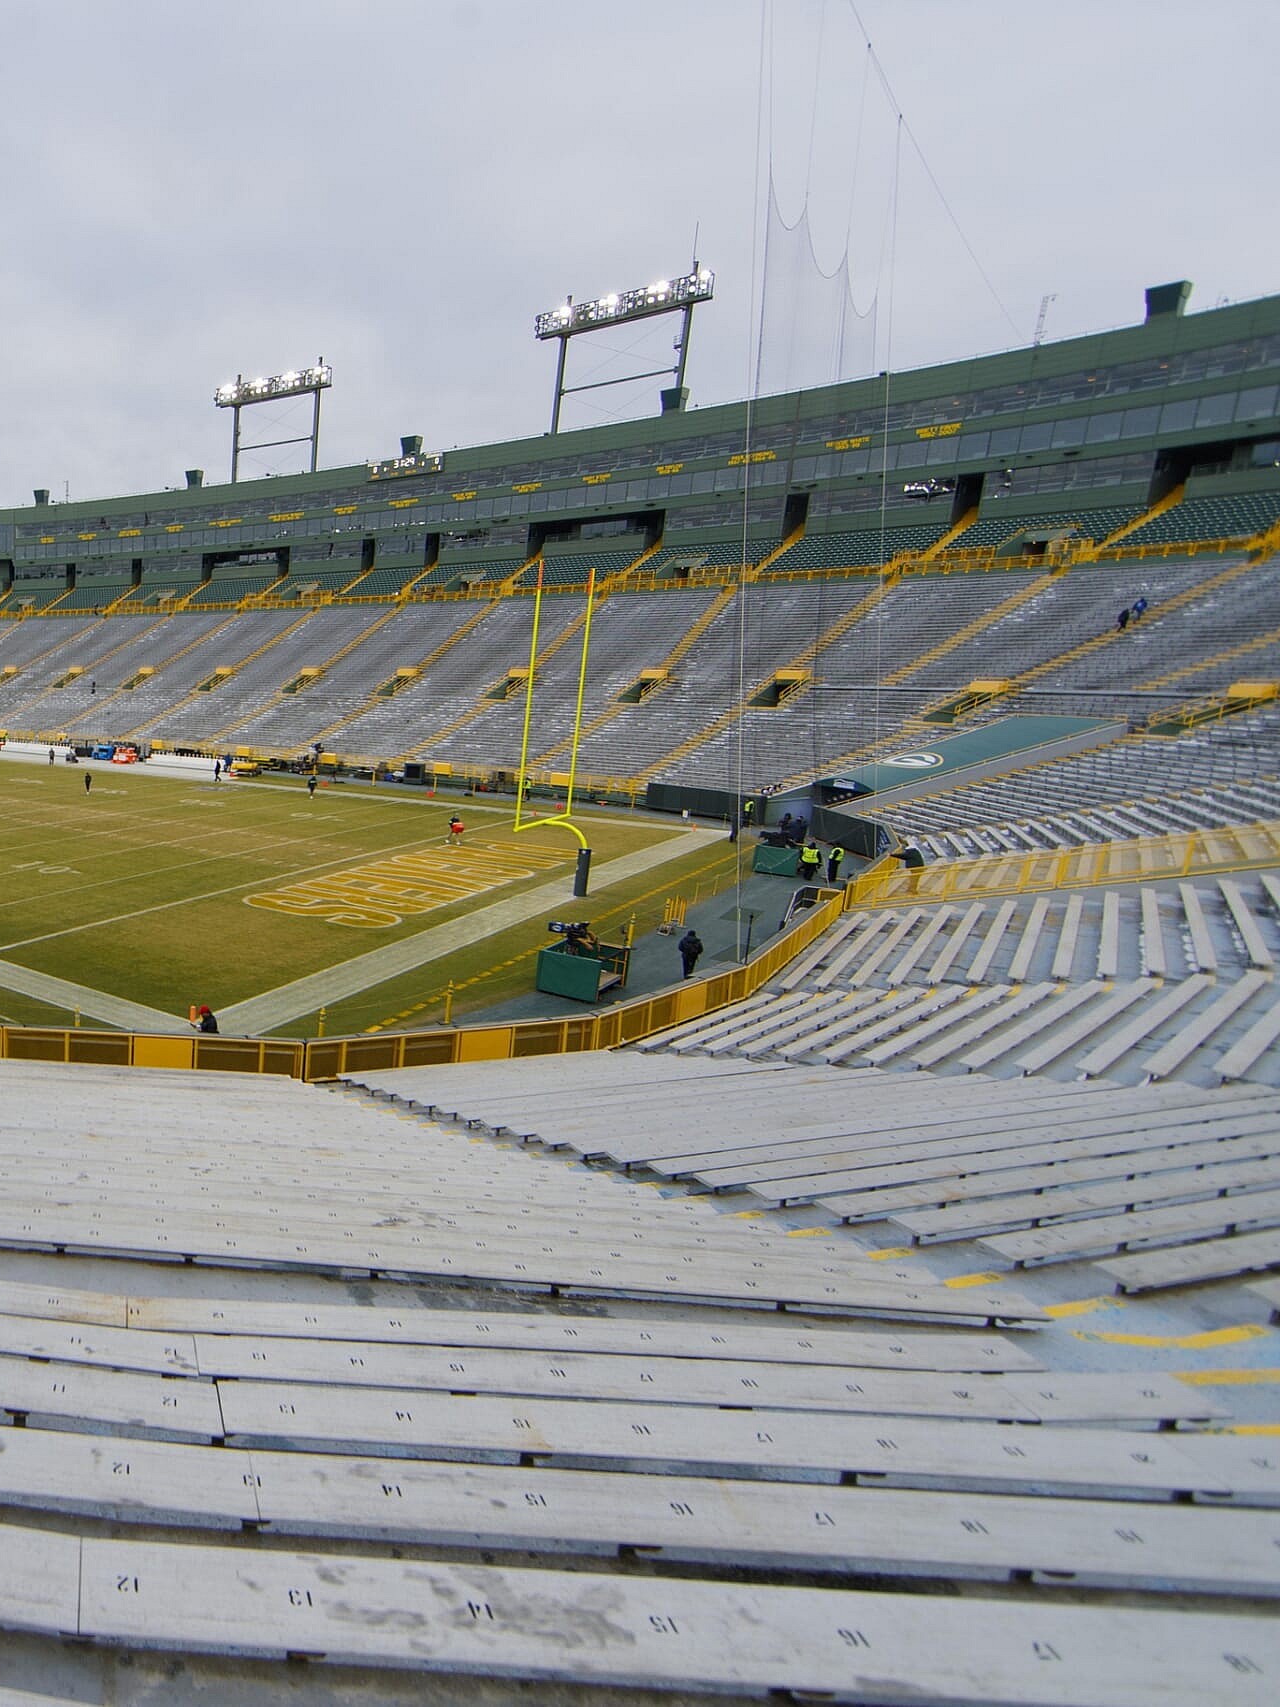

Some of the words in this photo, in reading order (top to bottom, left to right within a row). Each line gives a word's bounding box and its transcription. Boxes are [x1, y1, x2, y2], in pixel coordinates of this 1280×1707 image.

[116, 1574, 140, 1594] 12
[287, 1588, 314, 1608] 13
[466, 1598, 496, 1623] 14
[647, 1614, 680, 1635] 15
[835, 1627, 872, 1649] 16
